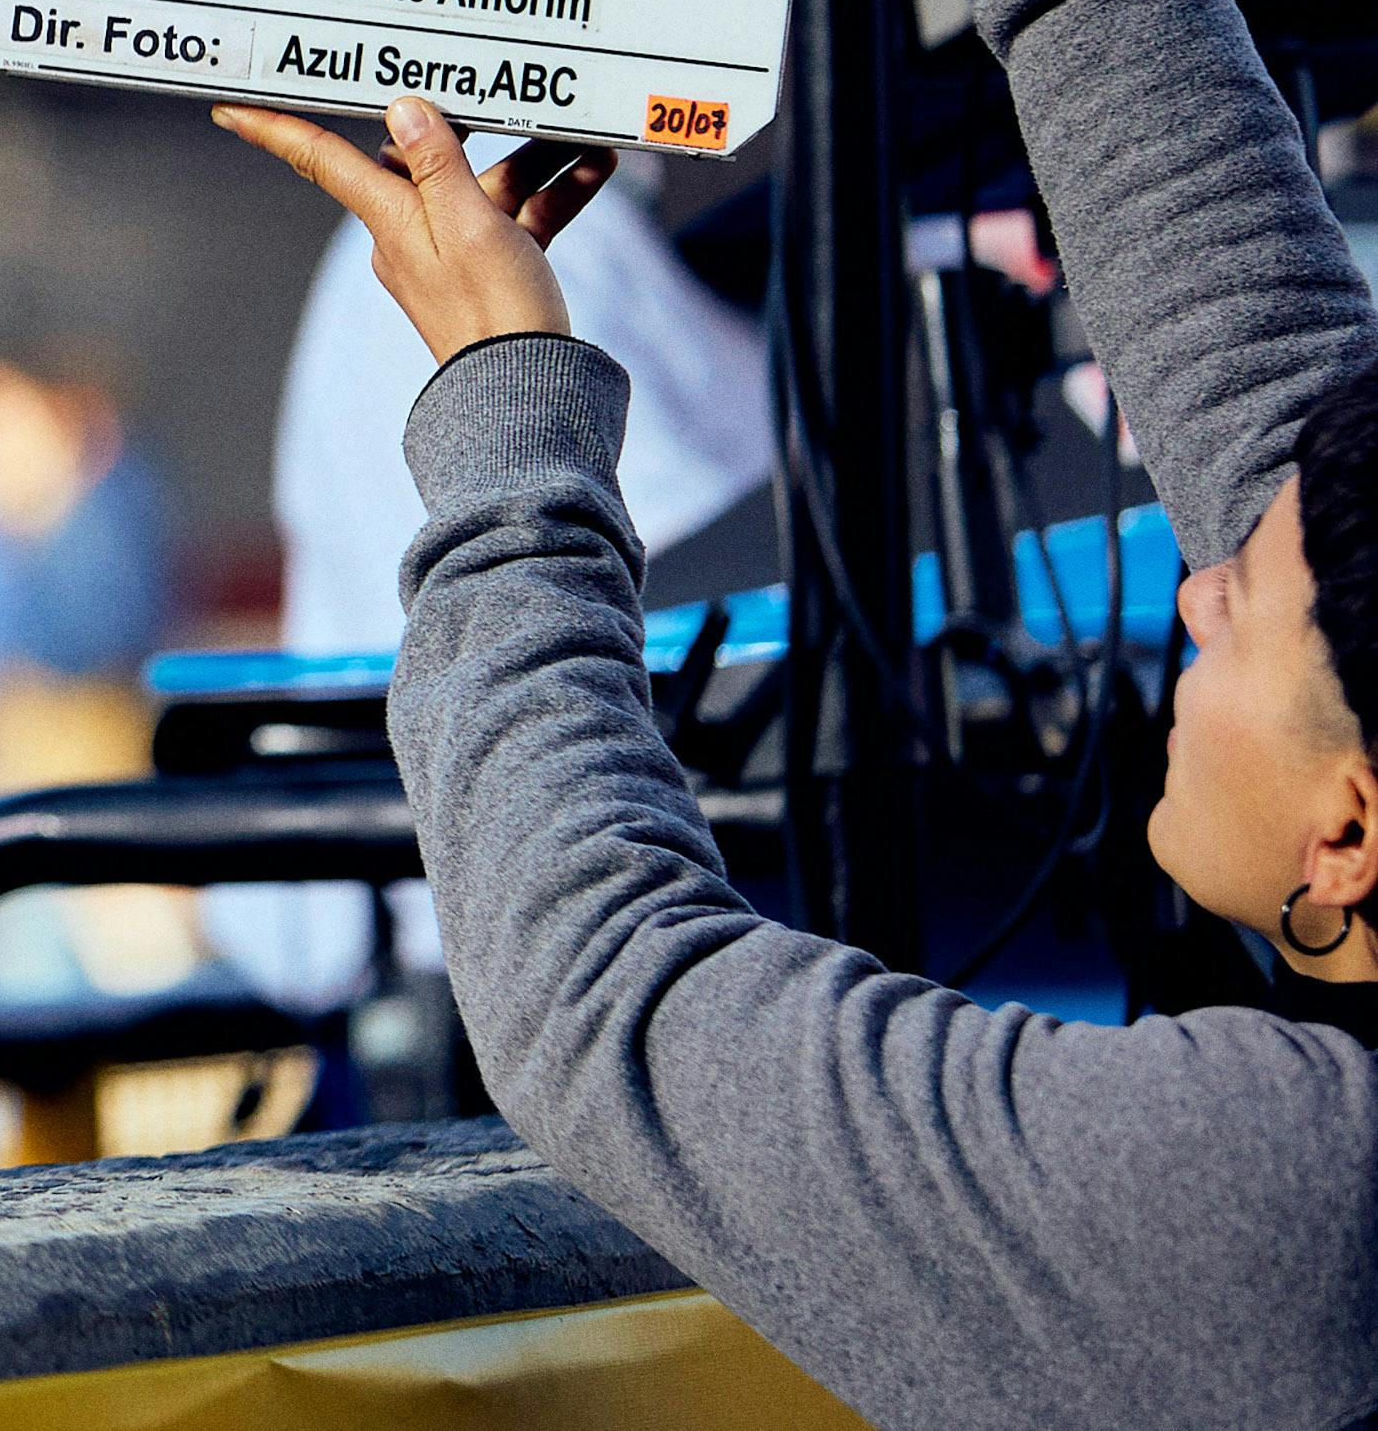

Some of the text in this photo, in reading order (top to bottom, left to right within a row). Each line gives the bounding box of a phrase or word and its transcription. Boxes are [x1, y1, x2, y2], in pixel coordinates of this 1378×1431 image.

[11, 5, 85, 49] Dir.
[103, 16, 220, 66] Foto:
[276, 35, 364, 82] Azul
